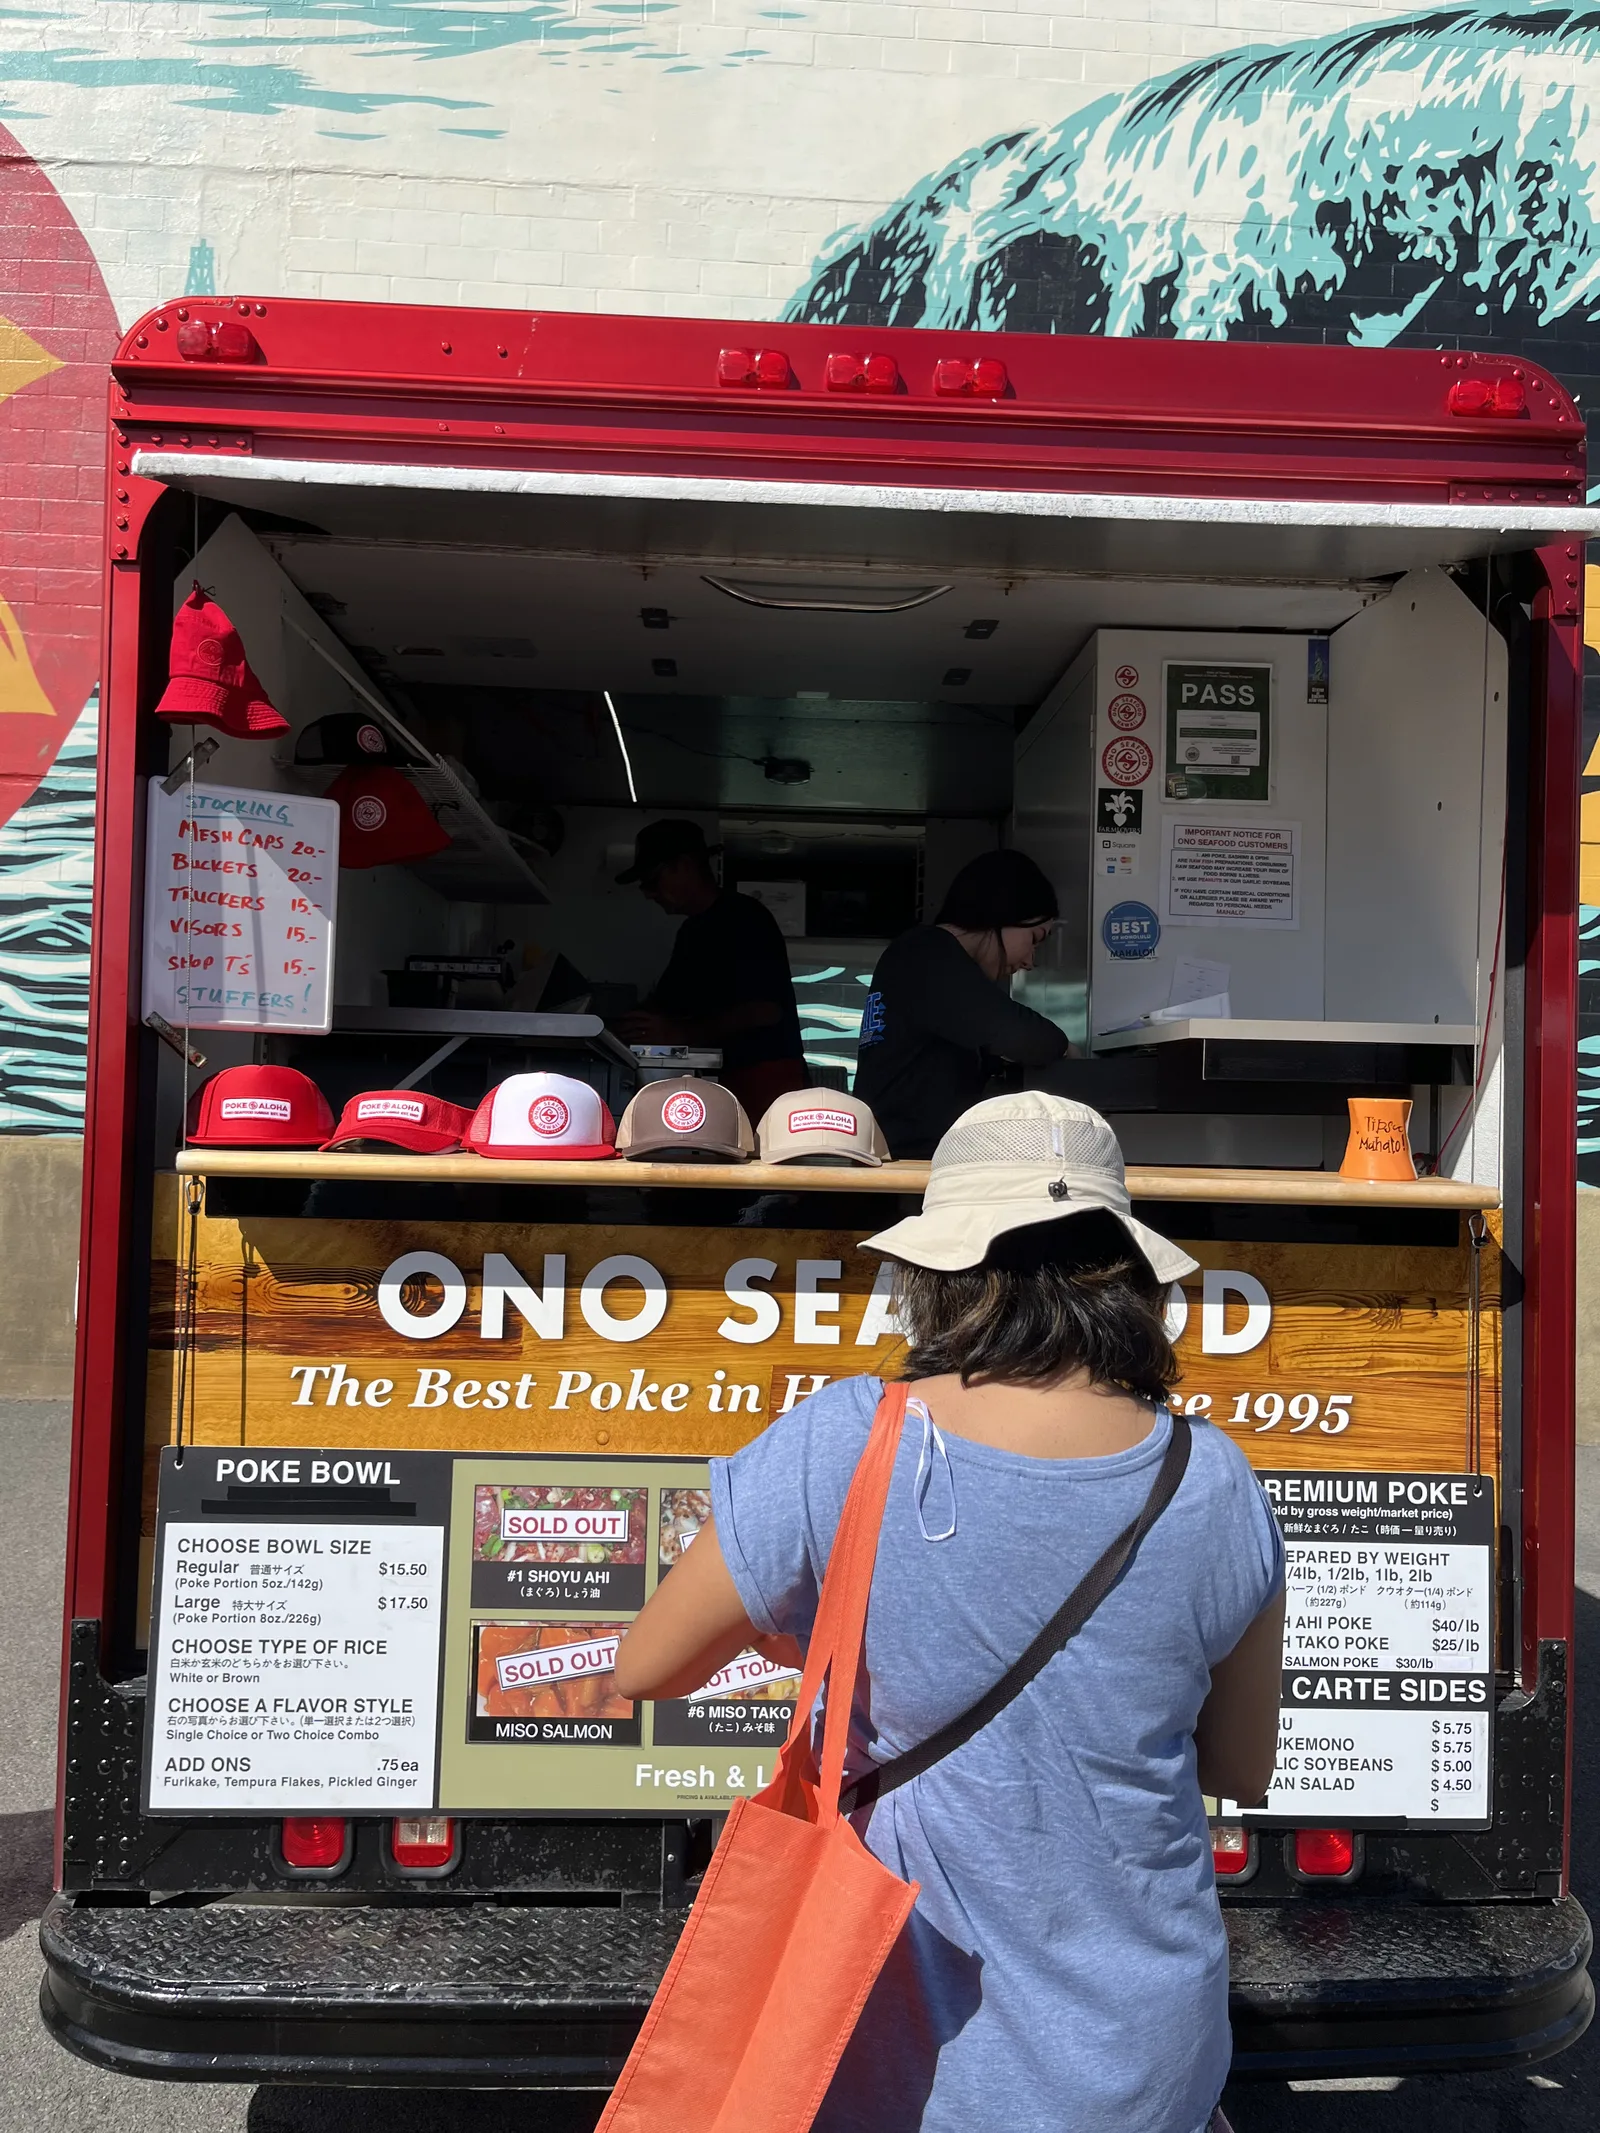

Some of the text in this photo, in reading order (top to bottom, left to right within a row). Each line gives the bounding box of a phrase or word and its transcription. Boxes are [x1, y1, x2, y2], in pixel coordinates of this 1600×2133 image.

[1182, 684, 1255, 706] PASS
[1122, 697, 1142, 717] SEAFOOD
[1117, 719, 1138, 728] HAWAII
[1108, 742, 1147, 767] ONO SEAFOOD
[1114, 771, 1142, 781] HAWAII
[186, 795, 290, 821] STOCKING
[179, 819, 233, 843] MESH
[238, 829, 284, 850] CAPS
[1185, 828, 1231, 837] IMPORTANT
[1238, 841, 1288, 850] CUSTOMERS
[171, 853, 258, 878] BUCKETS
[167, 886, 266, 911] TRUCKERS
[169, 919, 243, 937] VISORS
[1111, 921, 1150, 934] BEST
[259, 1103, 288, 1111] ALOHA
[391, 1104, 420, 1112] ALOHA
[543, 1102, 564, 1119] SEAFOOD
[679, 1099, 699, 1117] SEAFOOD
[793, 1114, 852, 1124] POKE ALOHA
[378, 1250, 1273, 1356] ONO SEAD
[288, 1363, 394, 1408] The
[407, 1367, 537, 1411] Best
[548, 1368, 690, 1413] Poke
[707, 1377, 762, 1414] in
[1228, 1391, 1354, 1435] 1995
[216, 1459, 400, 1484] POKE BOWL
[1260, 1479, 1468, 1505] REMIUM POKE
[1290, 1506, 1453, 1520] by gross weight/market price)
[508, 1517, 621, 1535] SOLD OUT
[178, 1538, 371, 1554] CHOOSE BOWL SIZE
[1357, 1552, 1450, 1566] BY WEIGHT
[177, 1560, 427, 1577] Regular 普通サイズ $15.50
[1327, 1568, 1433, 1583] 1/2lb, 1lb, 2lb
[175, 1578, 323, 1591] (Poke Portion 5oz./142g)
[507, 1570, 610, 1584] #1 SHOYU AHI
[565, 1588, 600, 1599] しょう油
[174, 1595, 220, 1612] Large
[232, 1600, 287, 1611] 特大サイズ
[173, 1613, 321, 1626] (Poke Portion 8oz./226g)
[1295, 1616, 1322, 1629] AHI
[1328, 1616, 1372, 1630] POKE
[1432, 1619, 1480, 1633] $40/lb
[172, 1639, 387, 1655] CHOOSE TYPE OF RICE
[1295, 1636, 1340, 1649] TAKO
[1344, 1637, 1390, 1651] POKE
[1432, 1639, 1480, 1652] $25/lb
[504, 1647, 615, 1683] SOLD OUT
[1285, 1657, 1433, 1669] SALMON POKE $30/lb
[169, 1672, 260, 1683] White or Brown
[1292, 1677, 1391, 1700] CARTE
[1400, 1679, 1486, 1702] SIDES
[168, 1698, 413, 1713] CHOOSE A FLAVOR STYLE
[688, 1706, 791, 1719] #6 MISO TAKO
[496, 1723, 612, 1739] MISO SALMON
[742, 1722, 775, 1733] みそ味
[166, 1729, 379, 1742] Single Choice or Two Choice Combo
[165, 1757, 251, 1772] ADD ONS
[1304, 1758, 1393, 1772] SOYBEANS
[164, 1776, 417, 1789] Furikake, Tempura Flakes, Pickled Ginger
[636, 1764, 714, 1787] Fresh
[726, 1765, 745, 1788] &
[1300, 1777, 1355, 1790] SALAD
